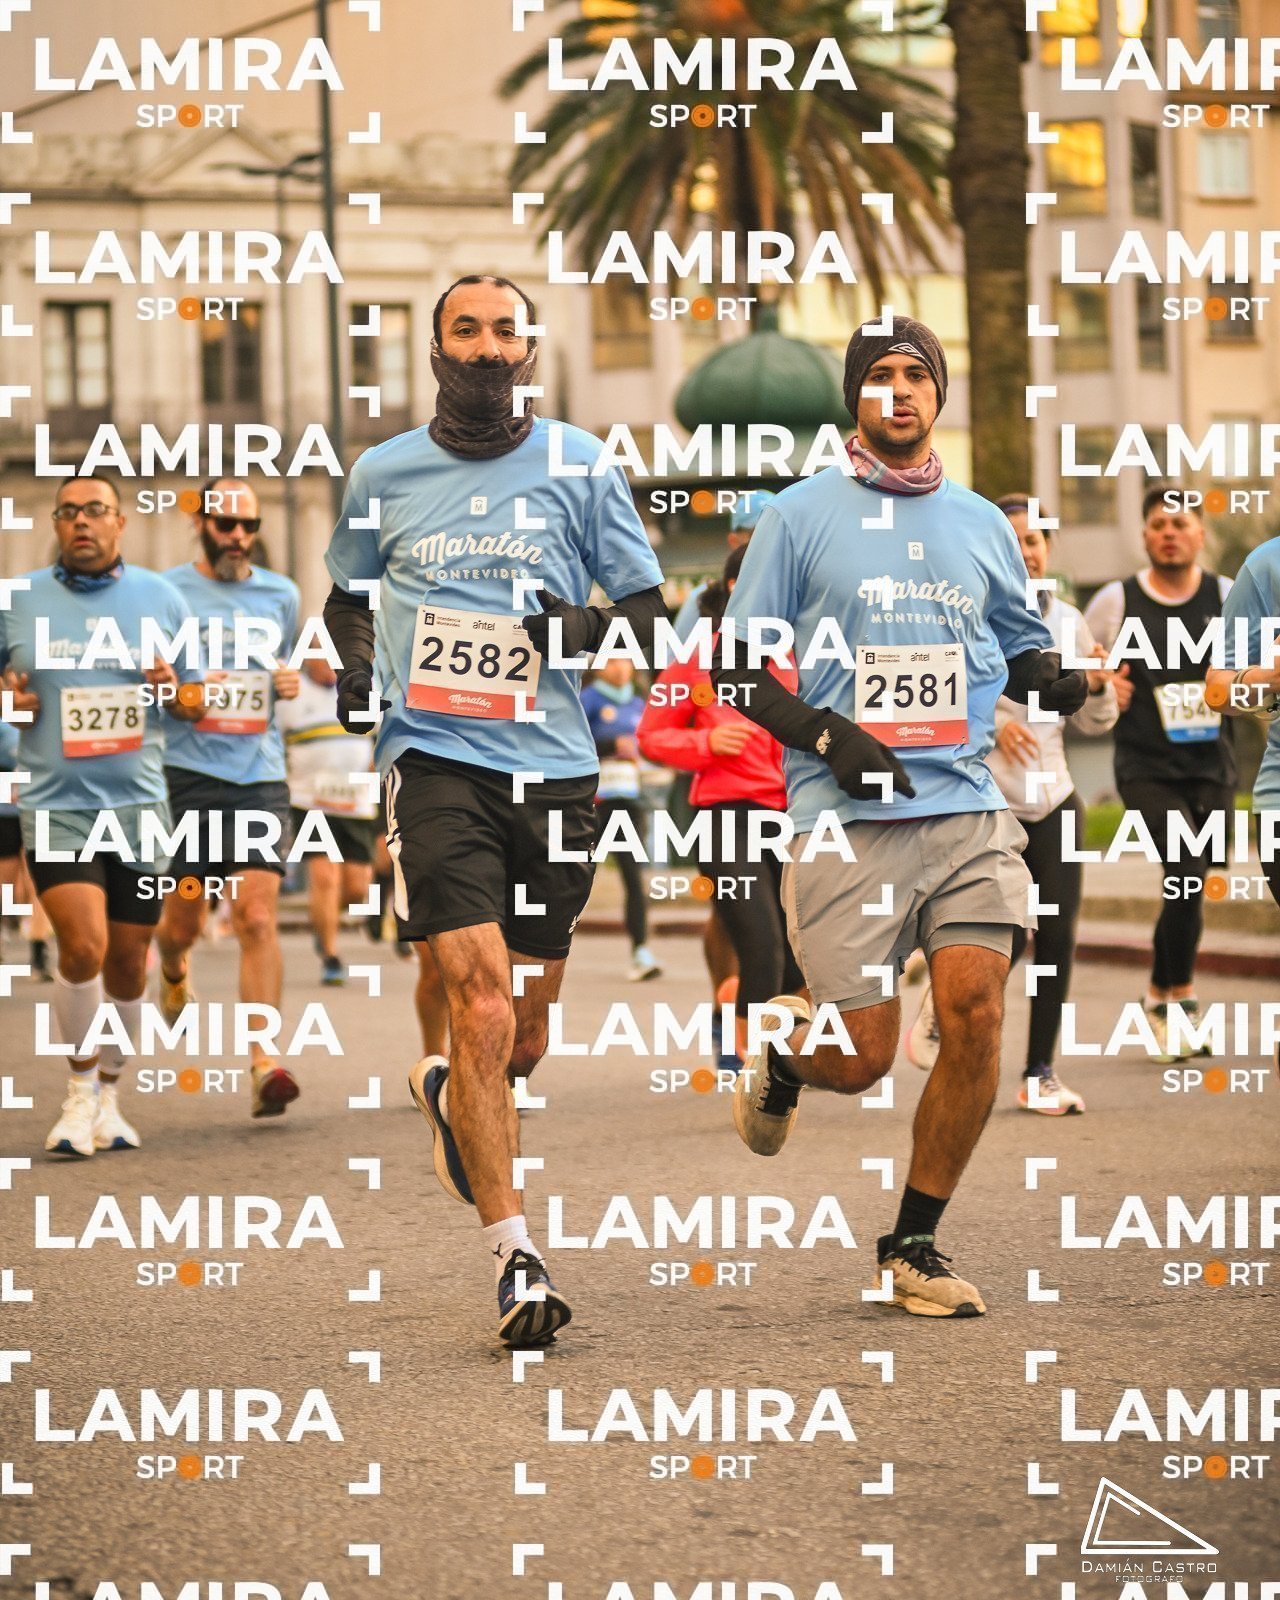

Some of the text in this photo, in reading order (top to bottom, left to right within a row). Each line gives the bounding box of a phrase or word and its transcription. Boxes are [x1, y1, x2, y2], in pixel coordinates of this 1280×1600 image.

[411, 532, 543, 566] Maratón
[419, 636, 530, 682] 2582
[864, 672, 956, 708] 2581
[68, 706, 139, 731] 3278
